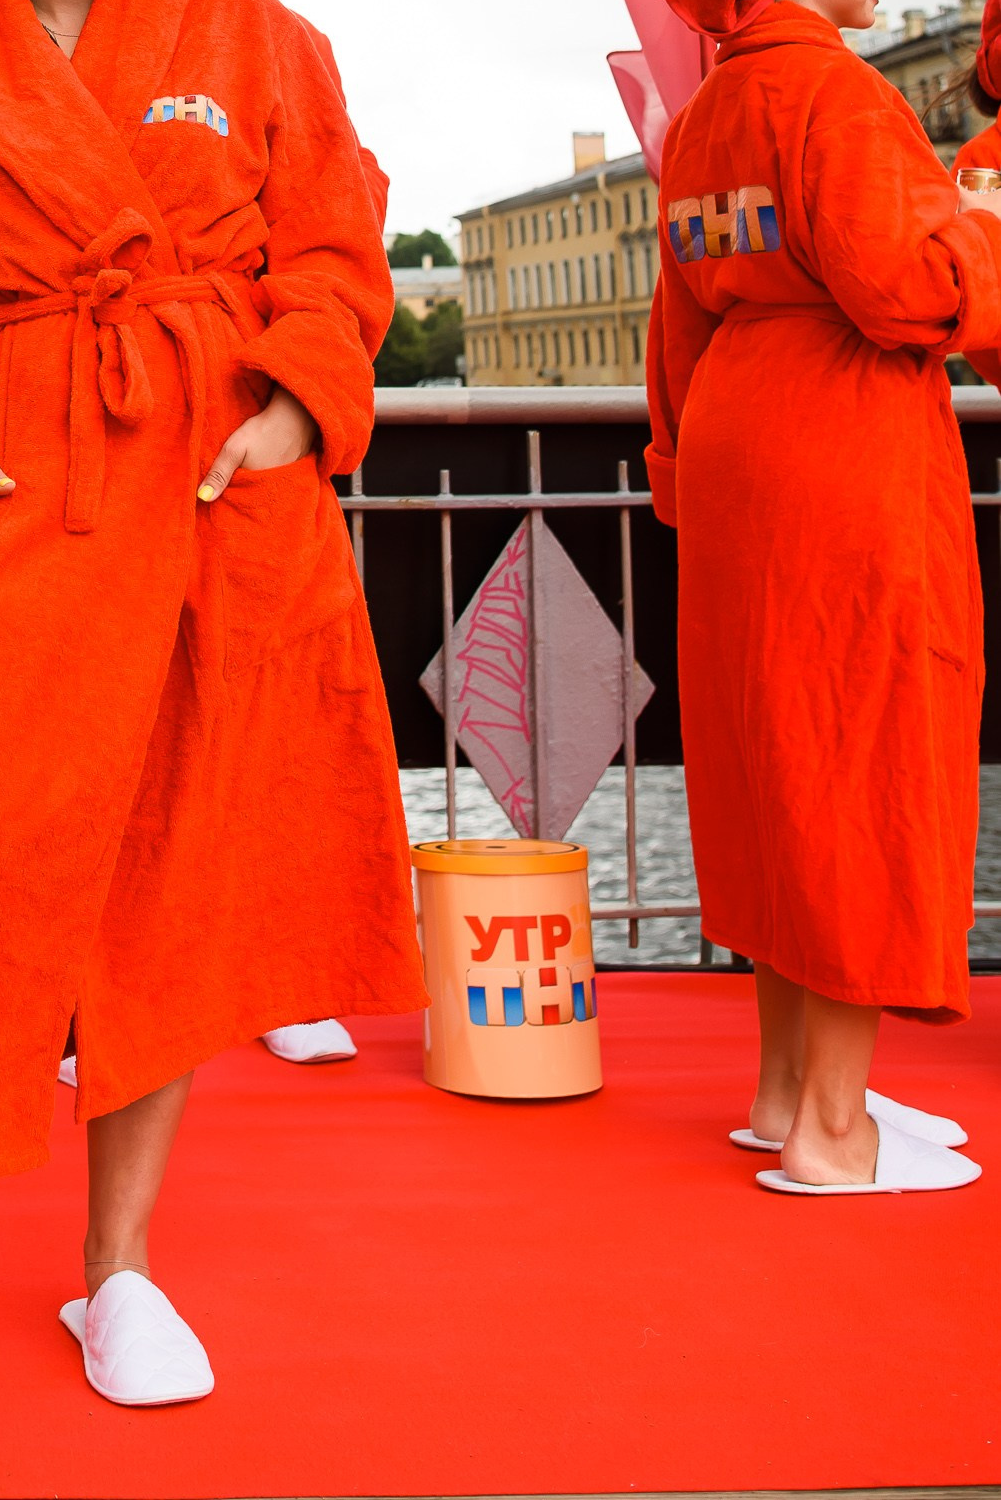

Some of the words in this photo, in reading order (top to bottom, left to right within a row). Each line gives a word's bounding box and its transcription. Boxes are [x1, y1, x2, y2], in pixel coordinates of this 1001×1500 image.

[142, 94, 229, 136] ТНТ
[667, 185, 781, 264] ТНТ
[466, 962, 597, 1027] ТНТ
